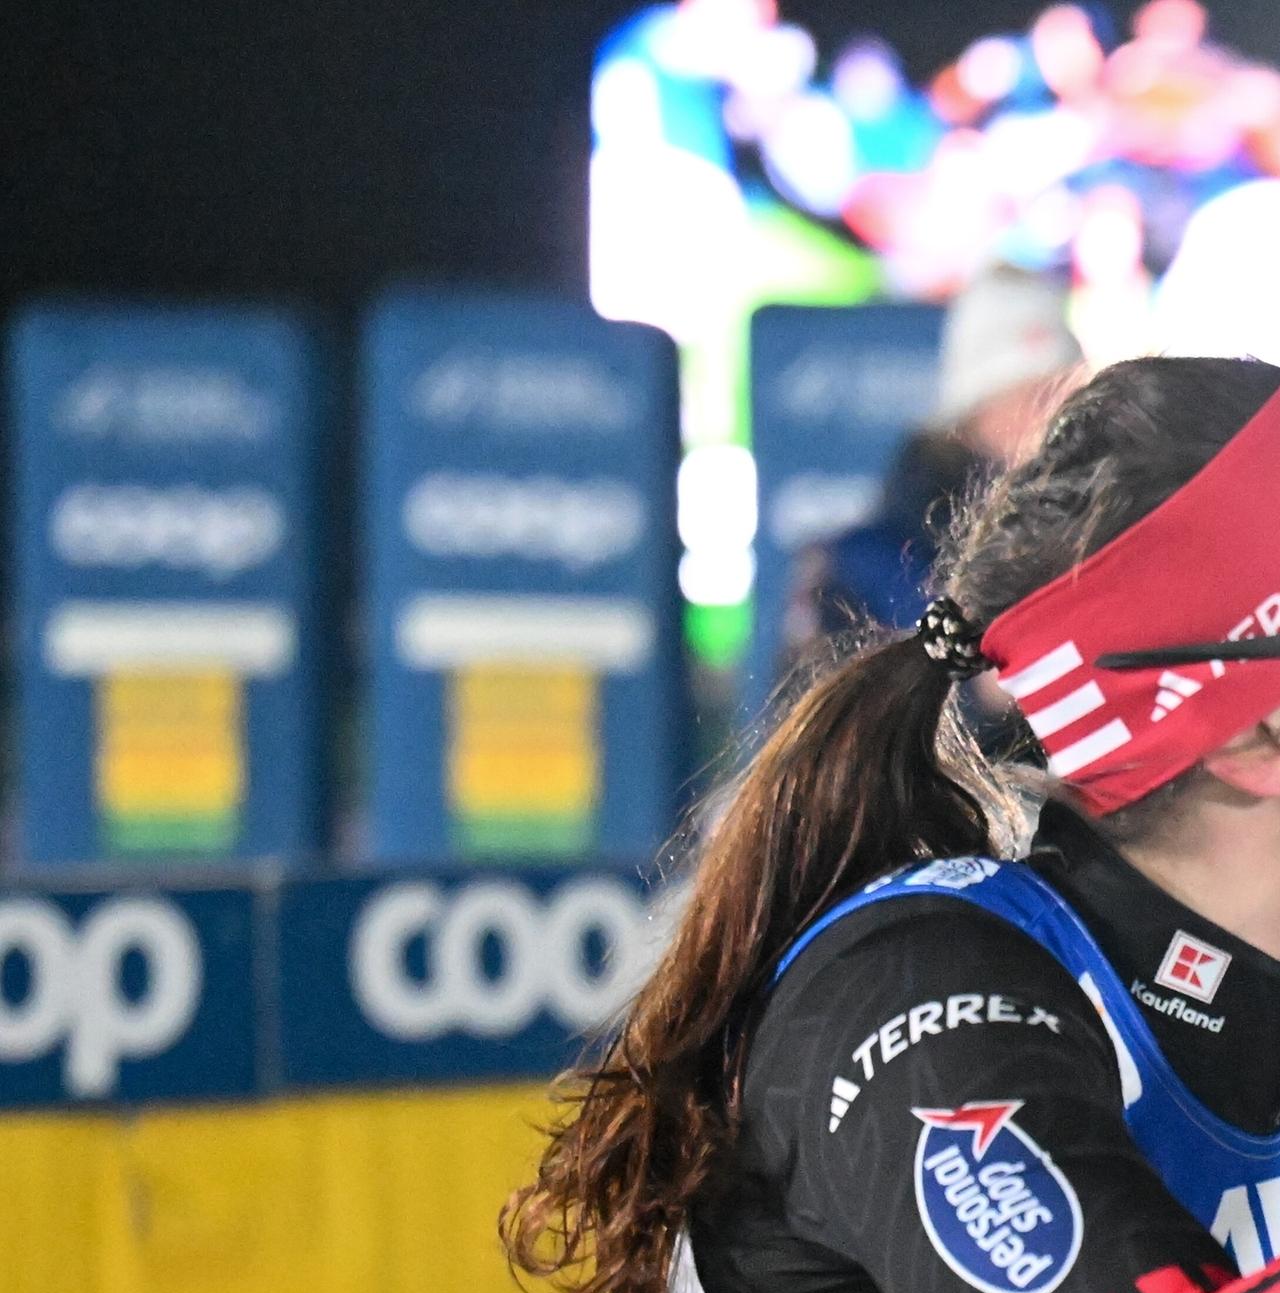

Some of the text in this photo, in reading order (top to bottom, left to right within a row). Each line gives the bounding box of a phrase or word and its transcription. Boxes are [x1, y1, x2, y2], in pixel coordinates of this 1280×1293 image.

[349, 876, 680, 1042] coo
[851, 993, 1062, 1082] TERREX
[1130, 977, 1226, 1034] Kaufland
[923, 1144, 1054, 1289] personal
[978, 1160, 1054, 1233] shop
